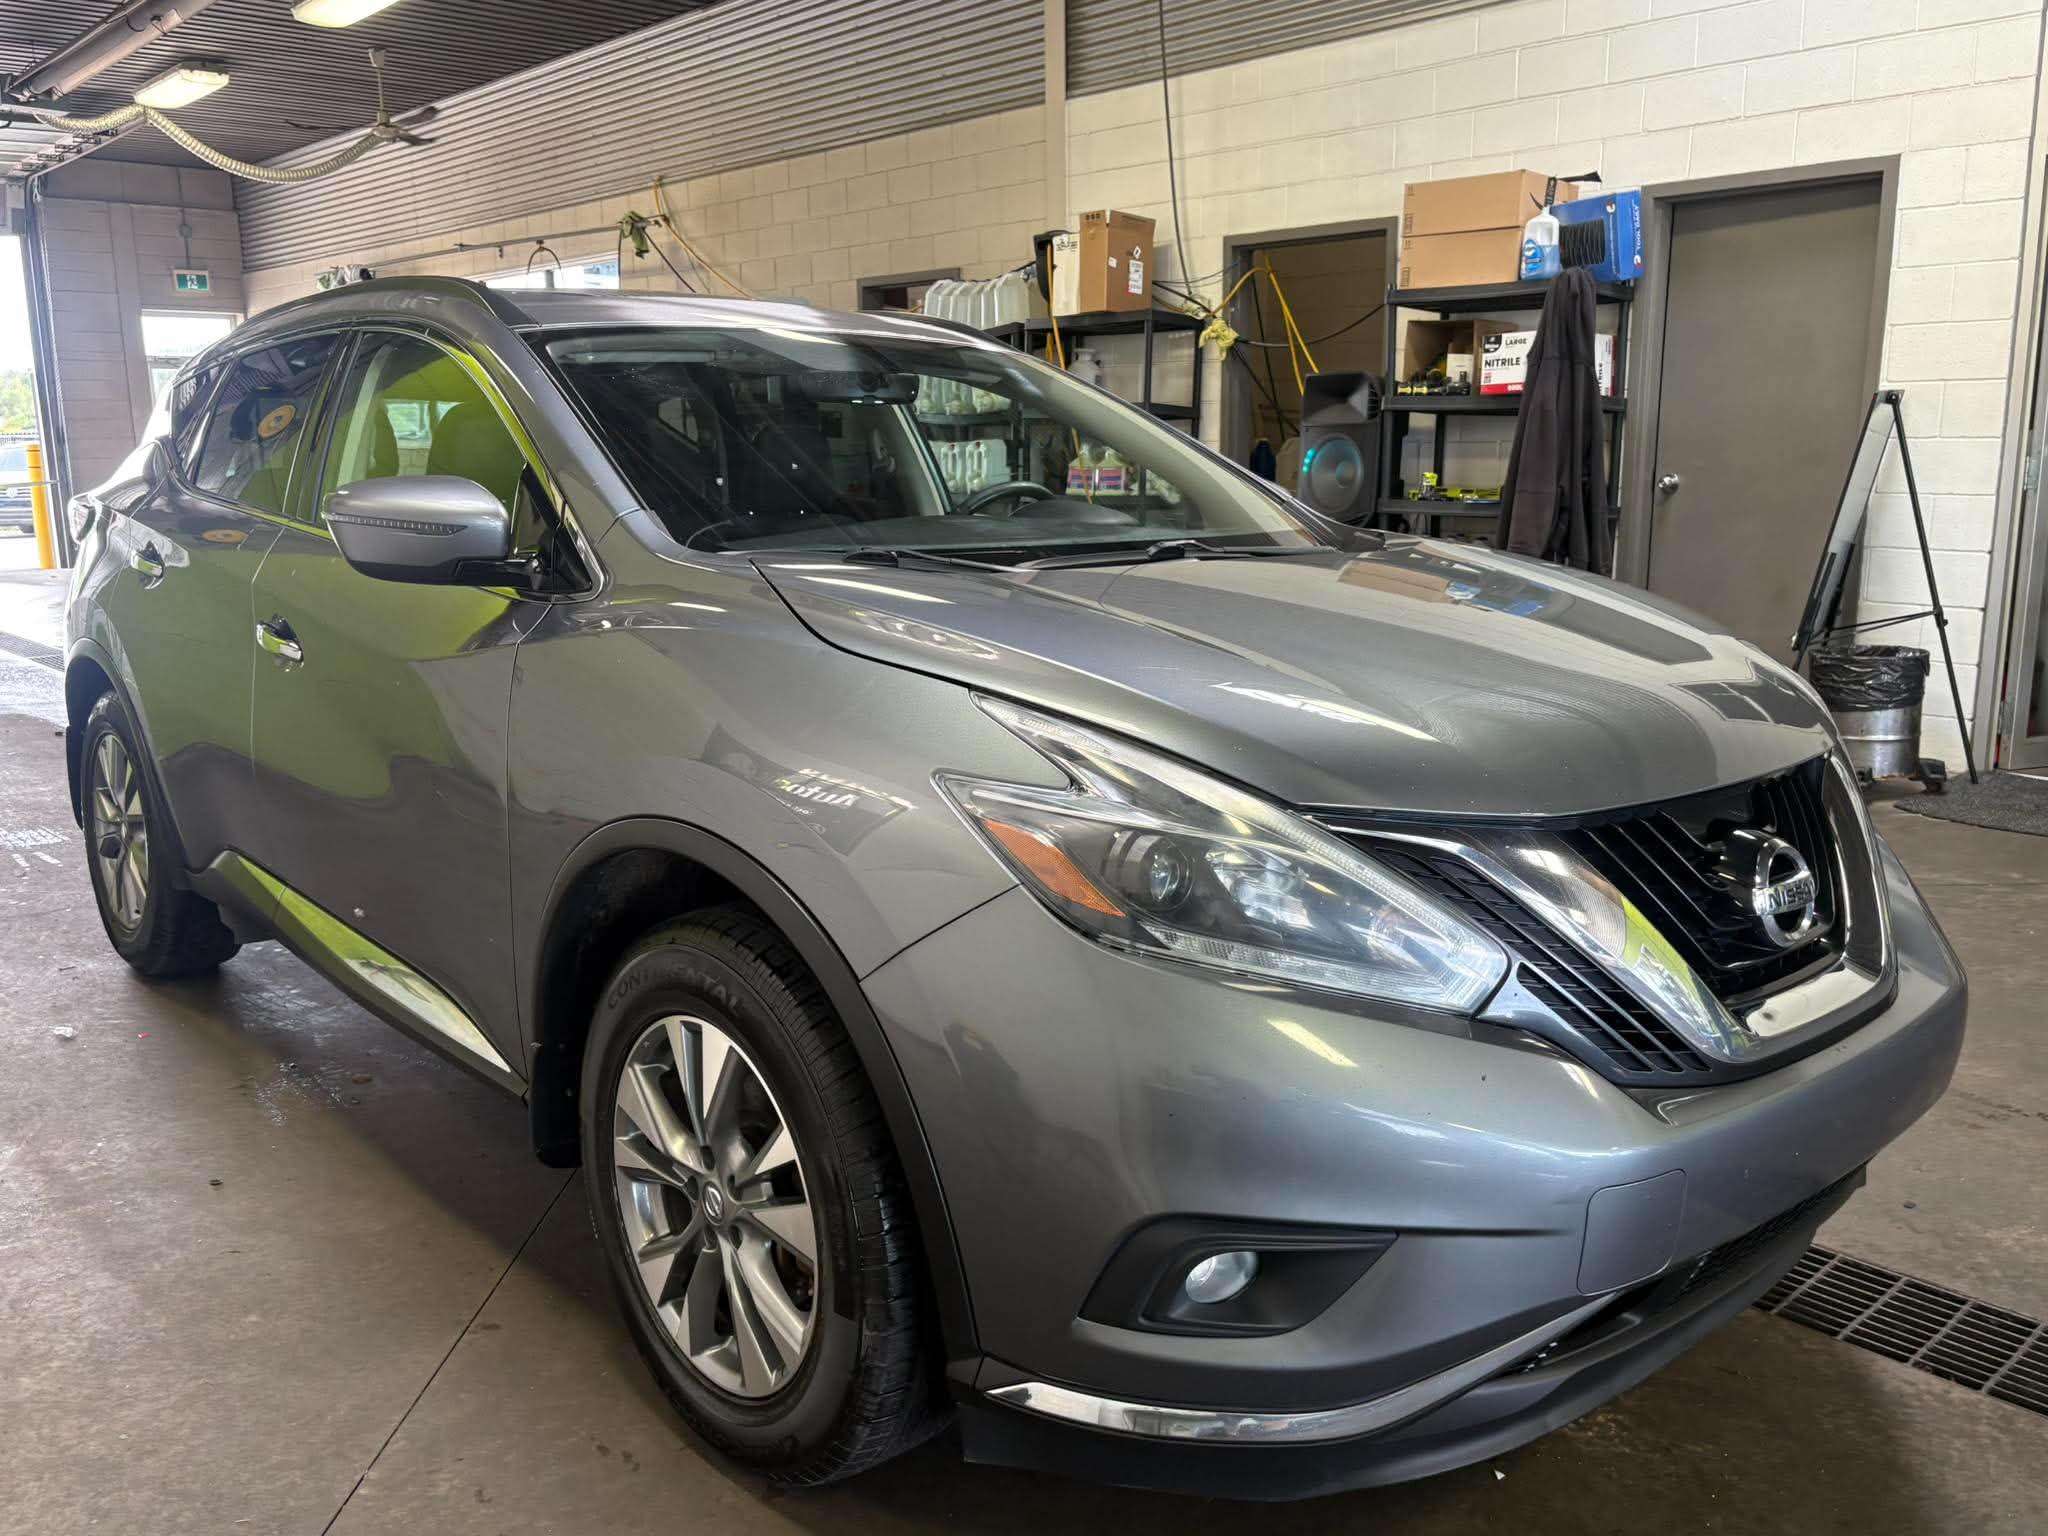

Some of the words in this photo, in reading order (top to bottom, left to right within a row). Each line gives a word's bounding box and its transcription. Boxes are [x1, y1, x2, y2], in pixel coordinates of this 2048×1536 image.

[1505, 337, 1528, 346] LARGE
[1484, 356, 1521, 369] NITRILE
[1768, 879, 1815, 909] NISSAN
